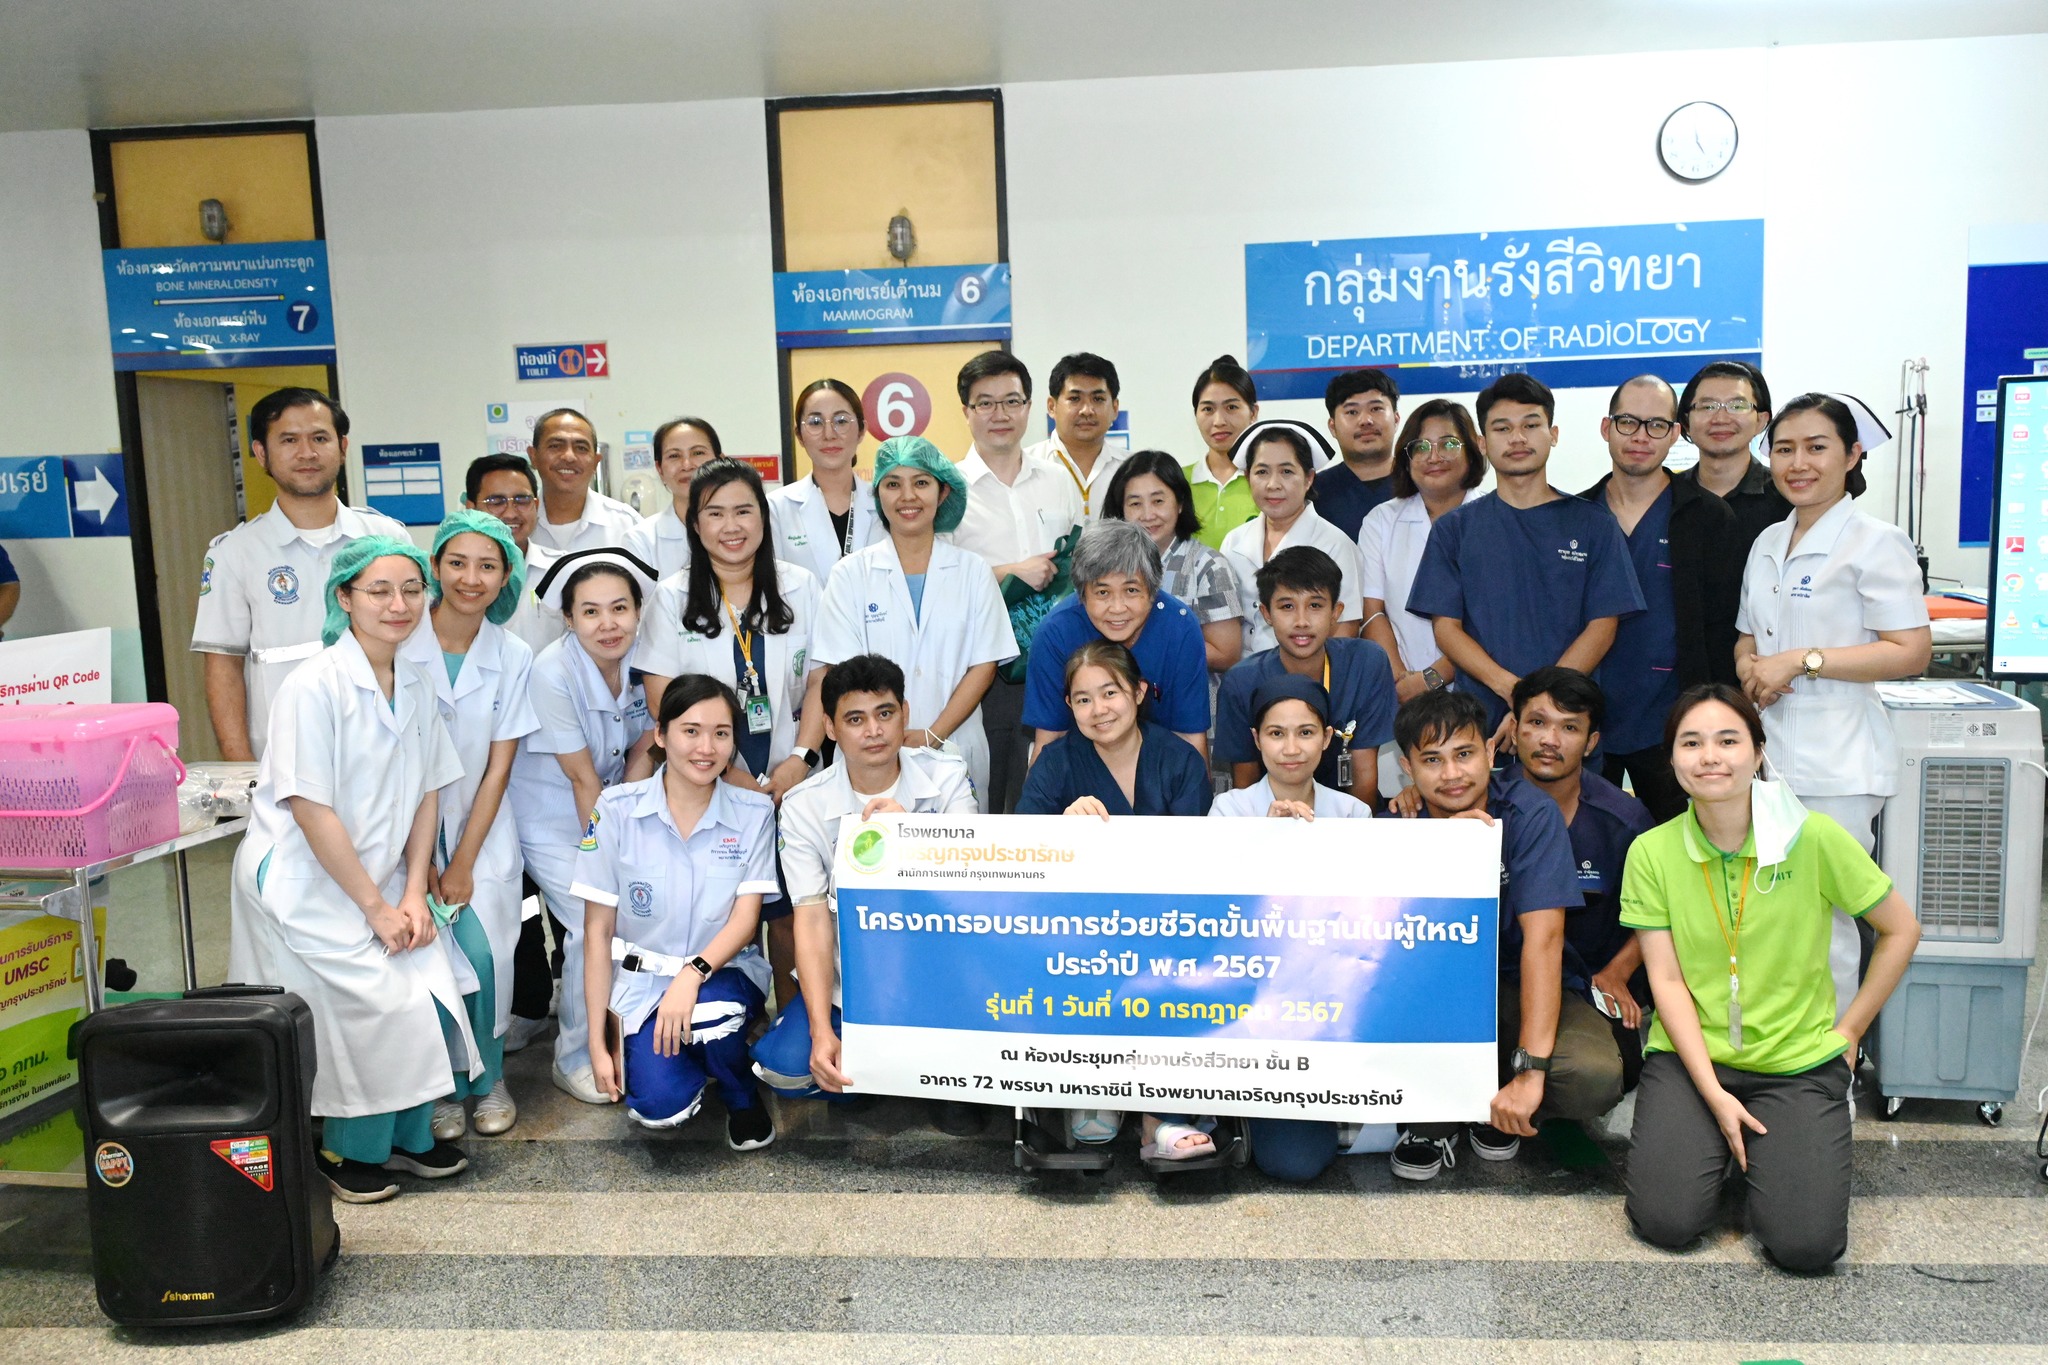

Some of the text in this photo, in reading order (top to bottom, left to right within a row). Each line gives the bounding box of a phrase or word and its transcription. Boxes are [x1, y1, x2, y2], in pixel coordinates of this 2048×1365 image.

[156, 281, 184, 292] BONE
[792, 278, 942, 303] ห้องเอกซเรย์เต้านม
[960, 276, 981, 304] 6
[1304, 236, 1702, 324] กลุ่มงานรังสีวิทยา
[292, 305, 310, 331] 7
[823, 308, 913, 322] MAMMOGRAM
[181, 333, 260, 346] DENTAL X-RAY
[1307, 318, 1711, 360] DEPARTMENT OF RADIOLOGY
[526, 367, 549, 377] TOILET
[877, 382, 916, 438] 6
[53, 674, 69, 690] QR
[73, 669, 100, 684] Code
[897, 822, 975, 839] โรงพยาบาล
[970, 869, 1045, 881] กรุงเทพมหานคร
[1769, 870, 1793, 882] MIT
[856, 904, 1479, 950] โครงการอบรมการช่วยชีวิตขั้นพื้นฐานในผู้ใหญ่
[4, 956, 50, 986] UMSC
[1046, 949, 1281, 978] ประจำปี พ.ศ. 2567
[985, 988, 1034, 1020] รุ่นที่
[1043, 996, 1053, 1016] 1
[1063, 989, 1112, 1017] วันที่
[1122, 997, 1150, 1018] 10
[1280, 1001, 1344, 1023] 2567
[1001, 1047, 1310, 1071] ณ ห้องประชุมกลุ่มงานรังสีวิทยา ชั้น B
[920, 1073, 1403, 1108] อาคาร 72 พรรษา มหาราชินี โรงพยาบาลเจริญกรุงประชารักษ์
[168, 1291, 215, 1301] sherman
